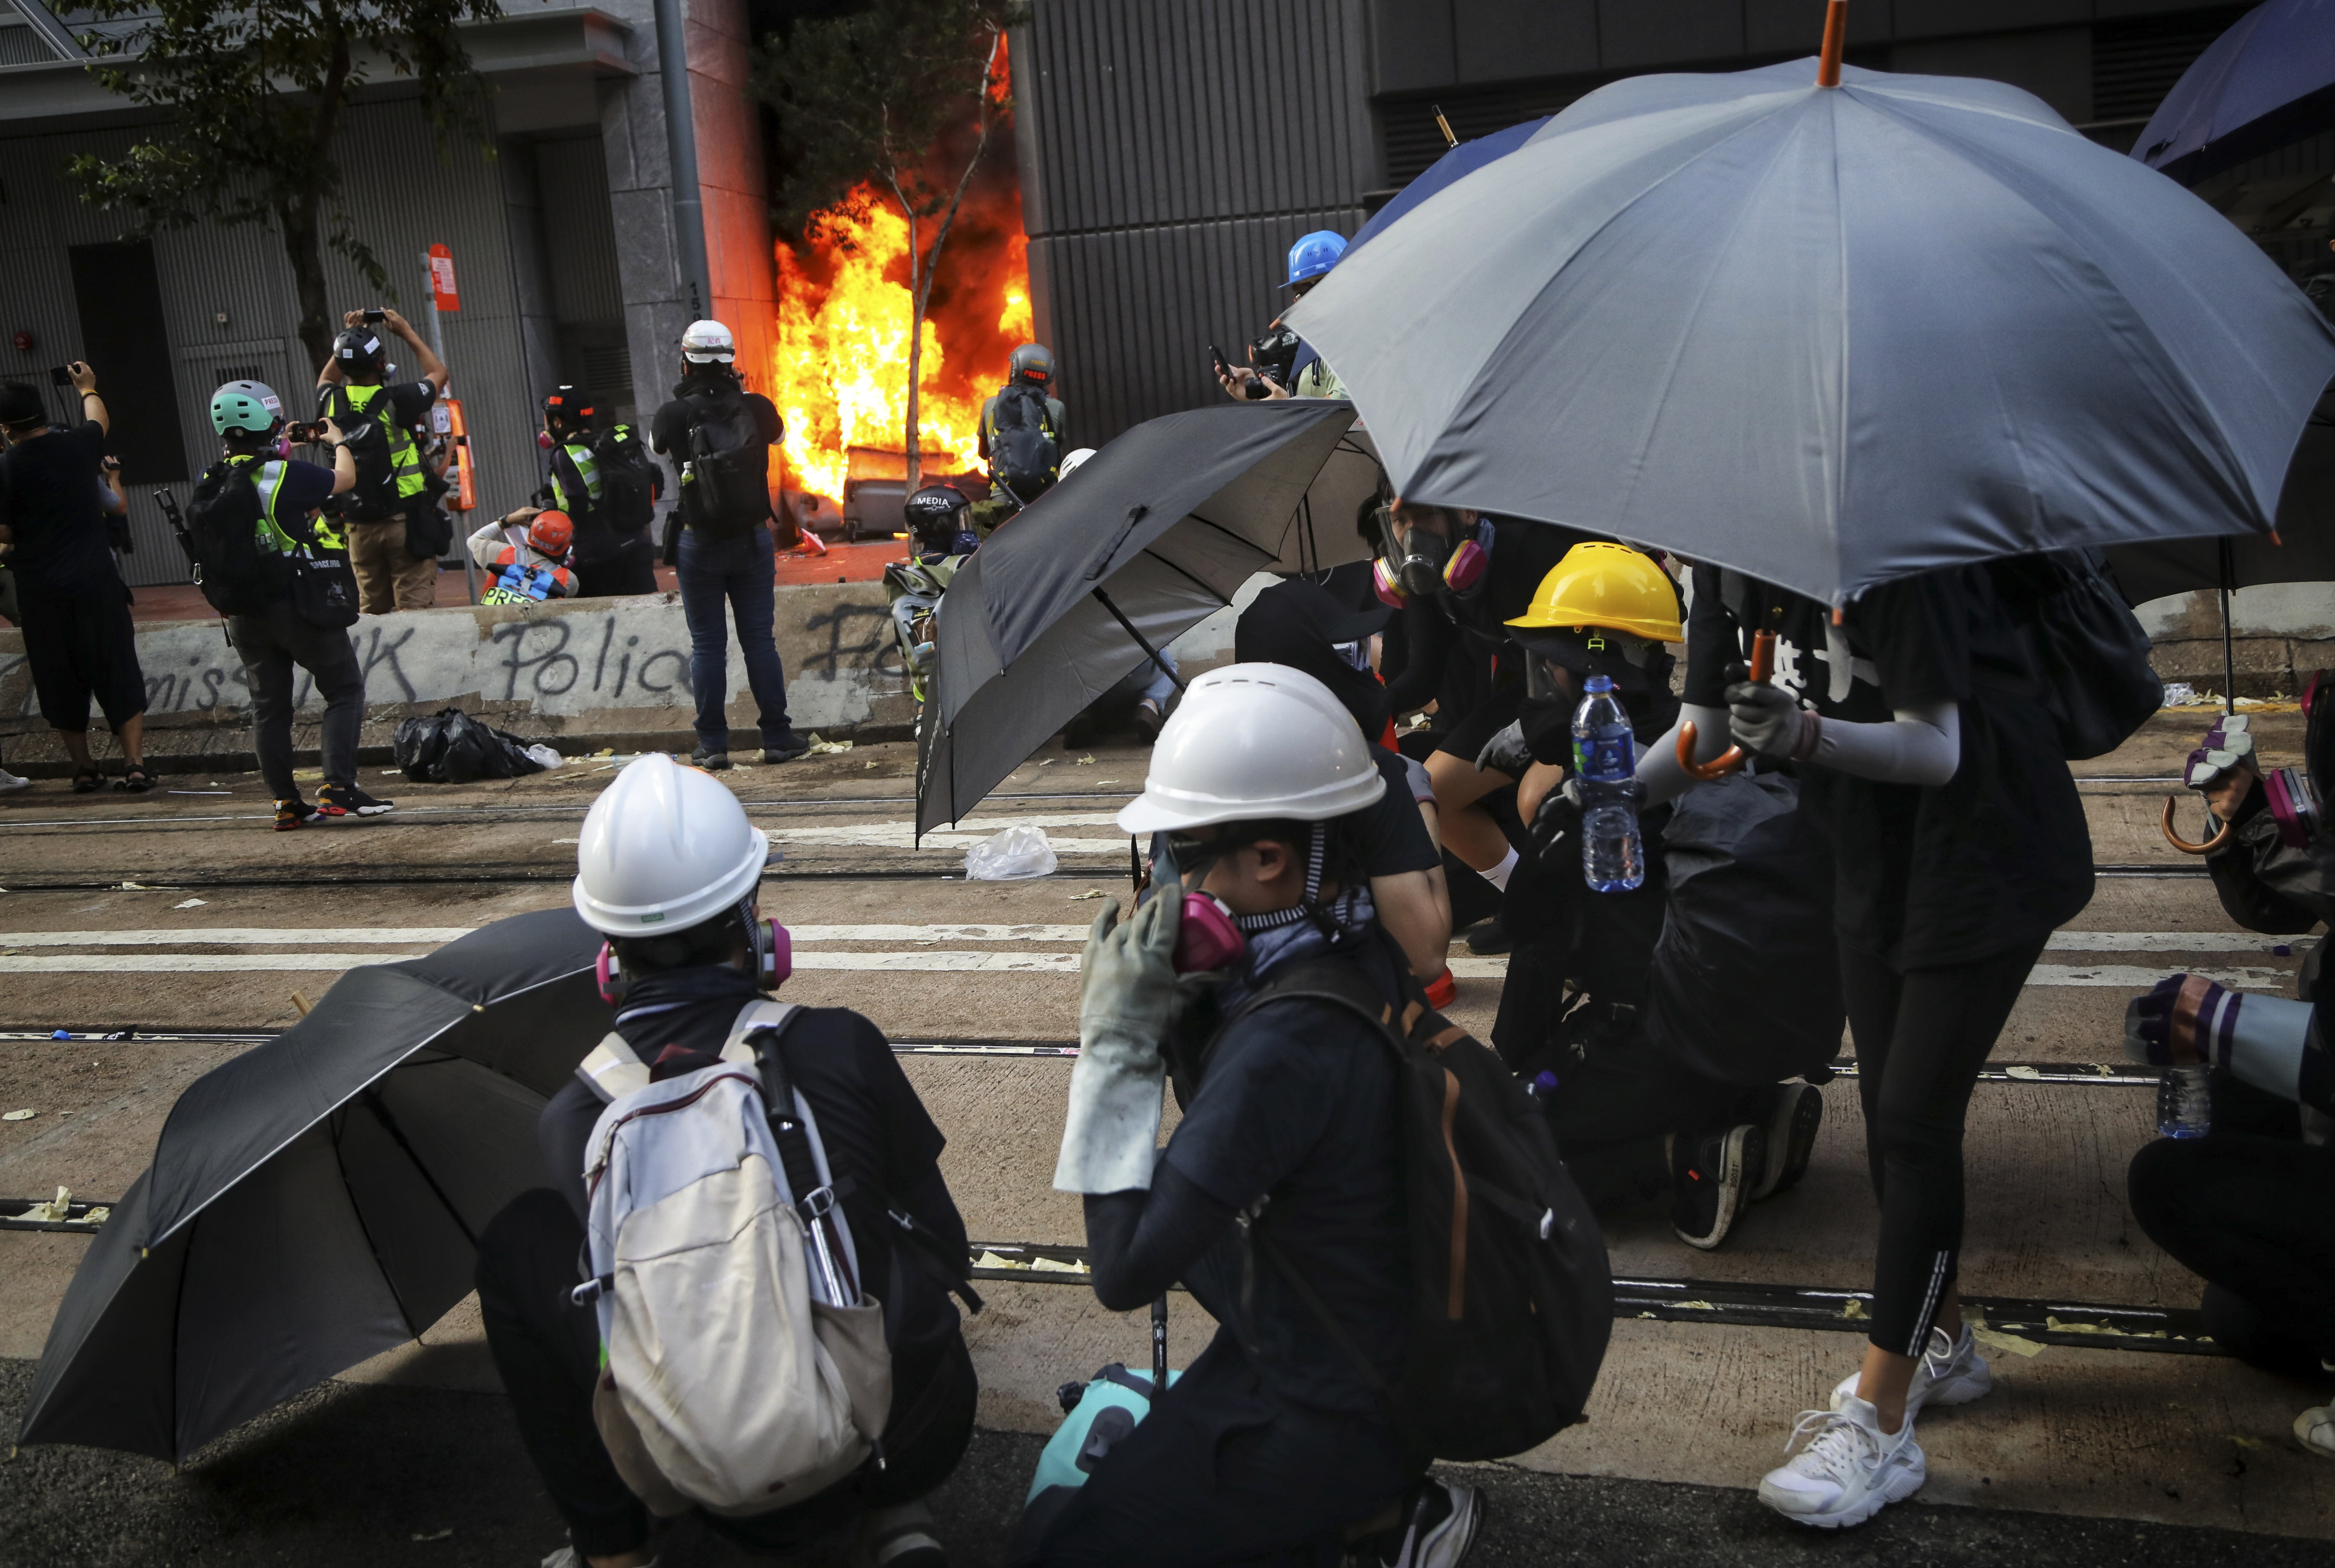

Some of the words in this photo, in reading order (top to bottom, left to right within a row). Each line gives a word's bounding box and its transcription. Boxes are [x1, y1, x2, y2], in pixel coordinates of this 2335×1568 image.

[1024, 369, 1047, 380] PRESS
[264, 397, 278, 405] PRESS
[917, 497, 949, 506] MEDIA
[531, 535, 555, 551] PRESS
[310, 560, 330, 569] SPACE
[493, 615, 693, 699] Polic
